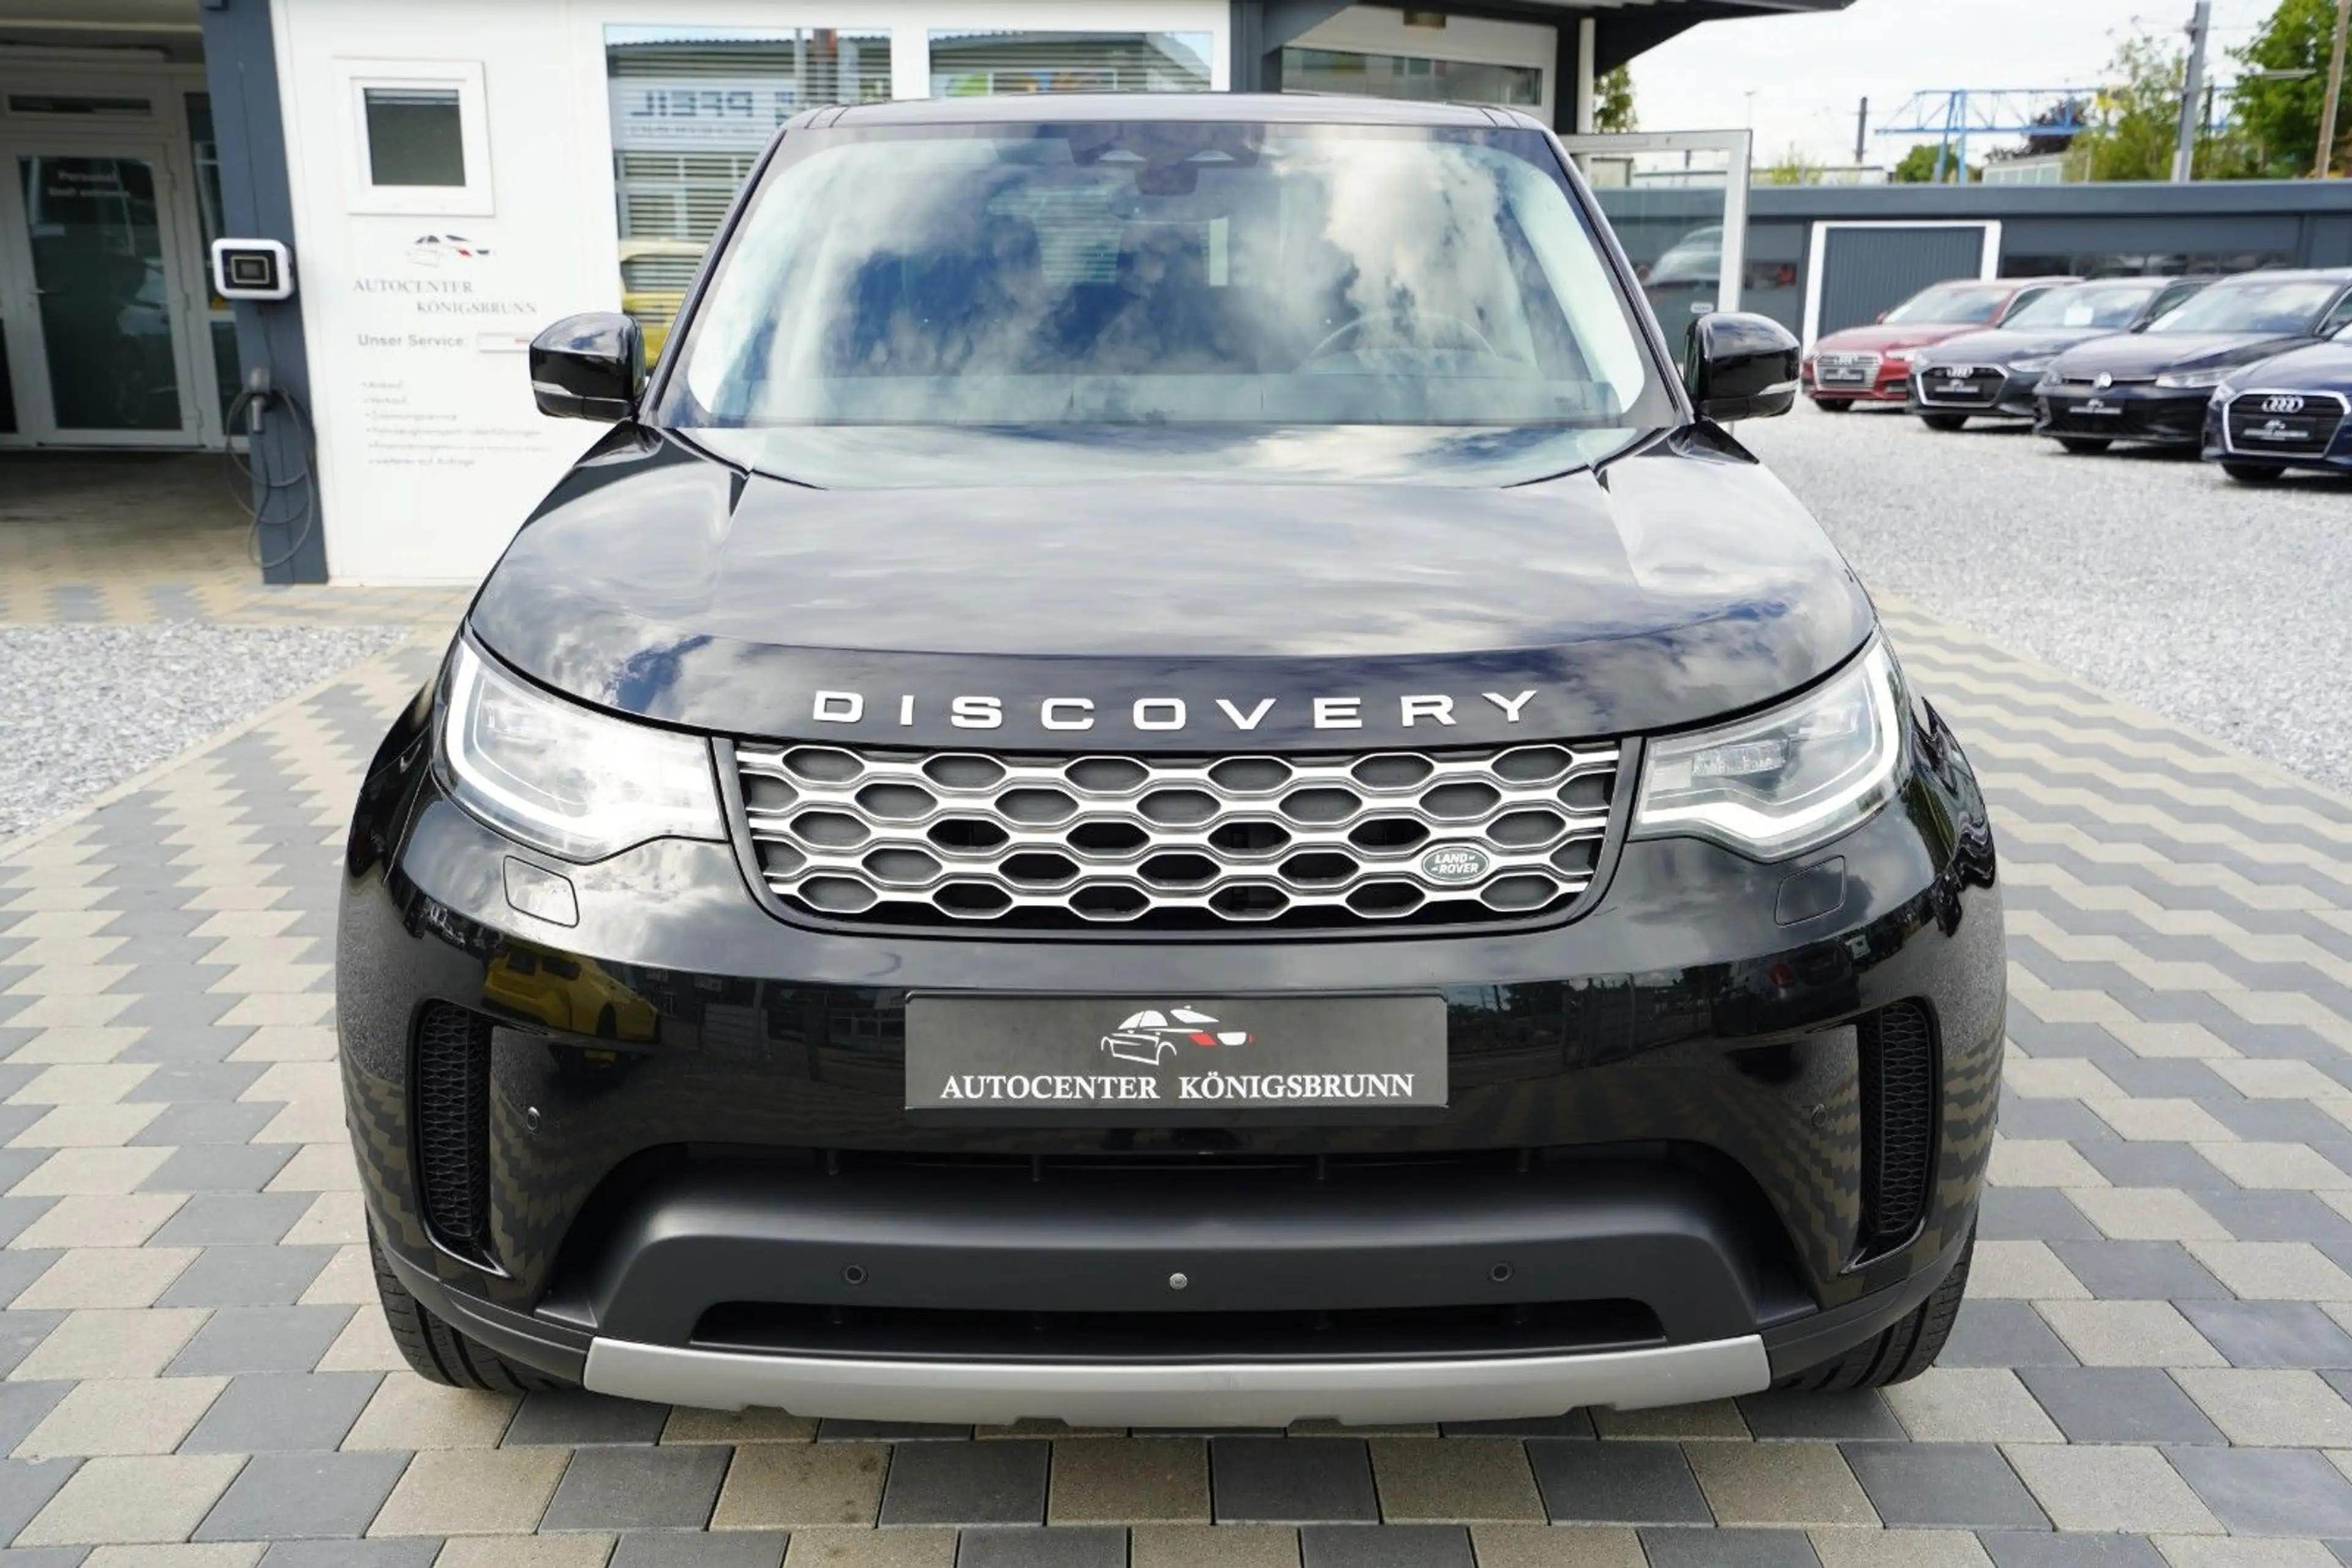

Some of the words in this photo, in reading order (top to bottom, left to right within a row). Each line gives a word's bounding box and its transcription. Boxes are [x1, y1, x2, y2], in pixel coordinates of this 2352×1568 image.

[352, 279, 472, 293] AUTOCENTER
[417, 300, 537, 314] KÖNIGSBRUNN
[358, 334, 402, 347] Unser
[408, 334, 464, 347] Service
[813, 690, 1537, 730] DISCOVERY
[1436, 853, 1468, 864] LAND
[1439, 863, 1479, 873] ROVER
[940, 1075, 1161, 1099] AUTOCENTER
[1178, 1071, 1415, 1099] KÖNIGSBRUNN
